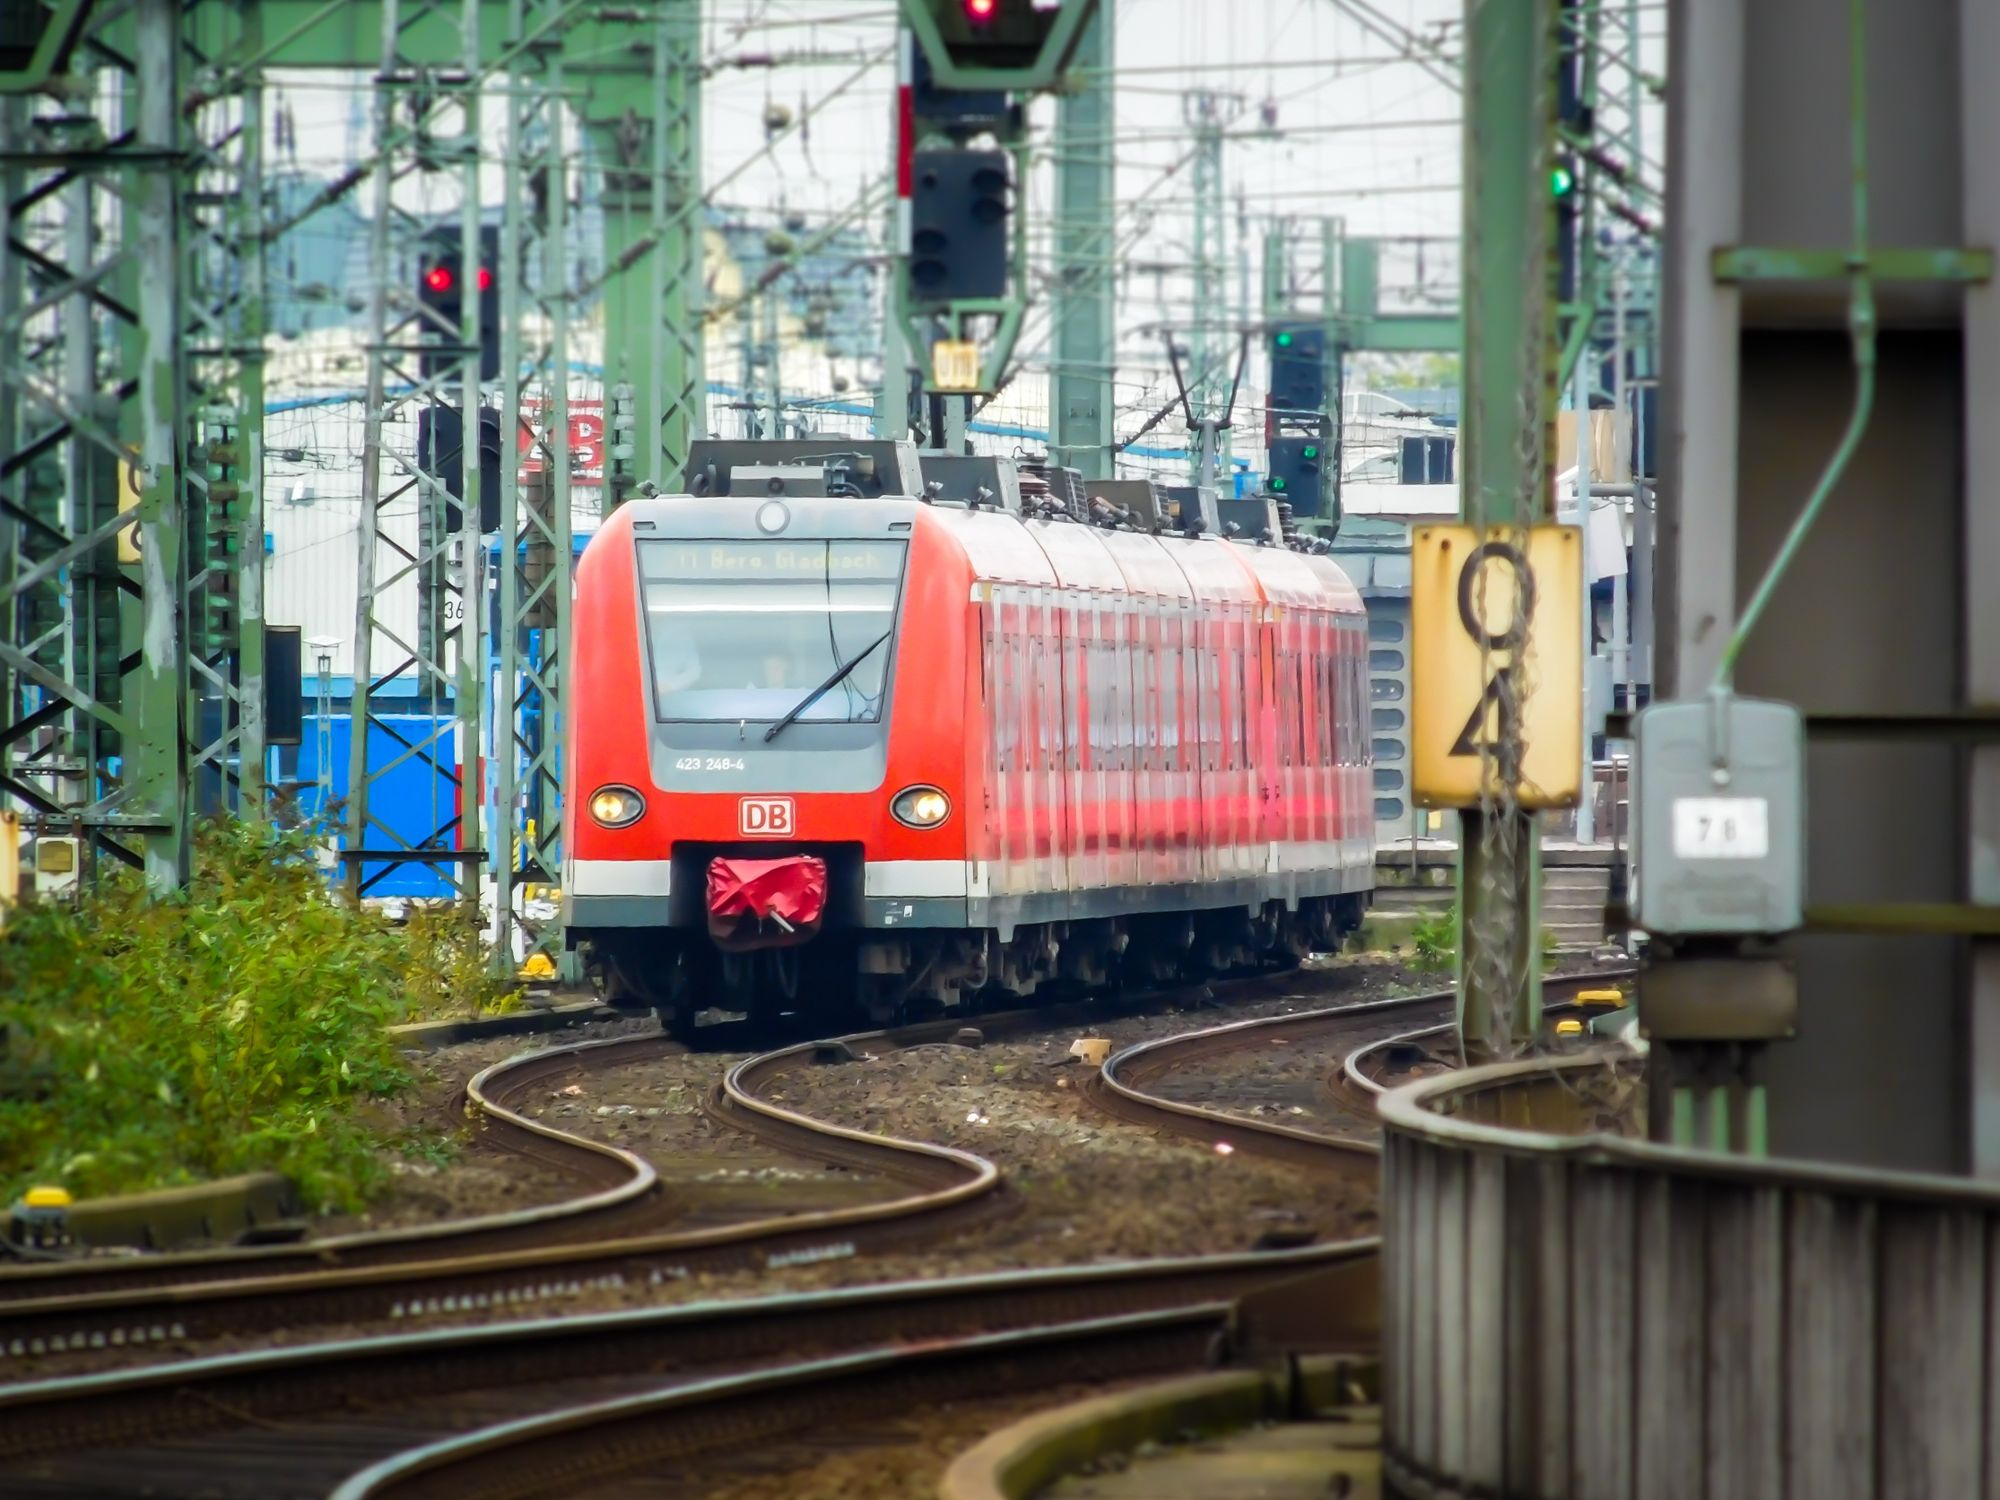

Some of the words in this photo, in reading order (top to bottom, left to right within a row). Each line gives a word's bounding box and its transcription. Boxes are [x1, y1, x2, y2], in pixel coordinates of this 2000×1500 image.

[1457, 541, 1536, 650] 0
[1448, 667, 1530, 782] 4
[676, 757, 702, 771] 423
[706, 757, 746, 771] 248-4
[746, 803, 789, 830] DB
